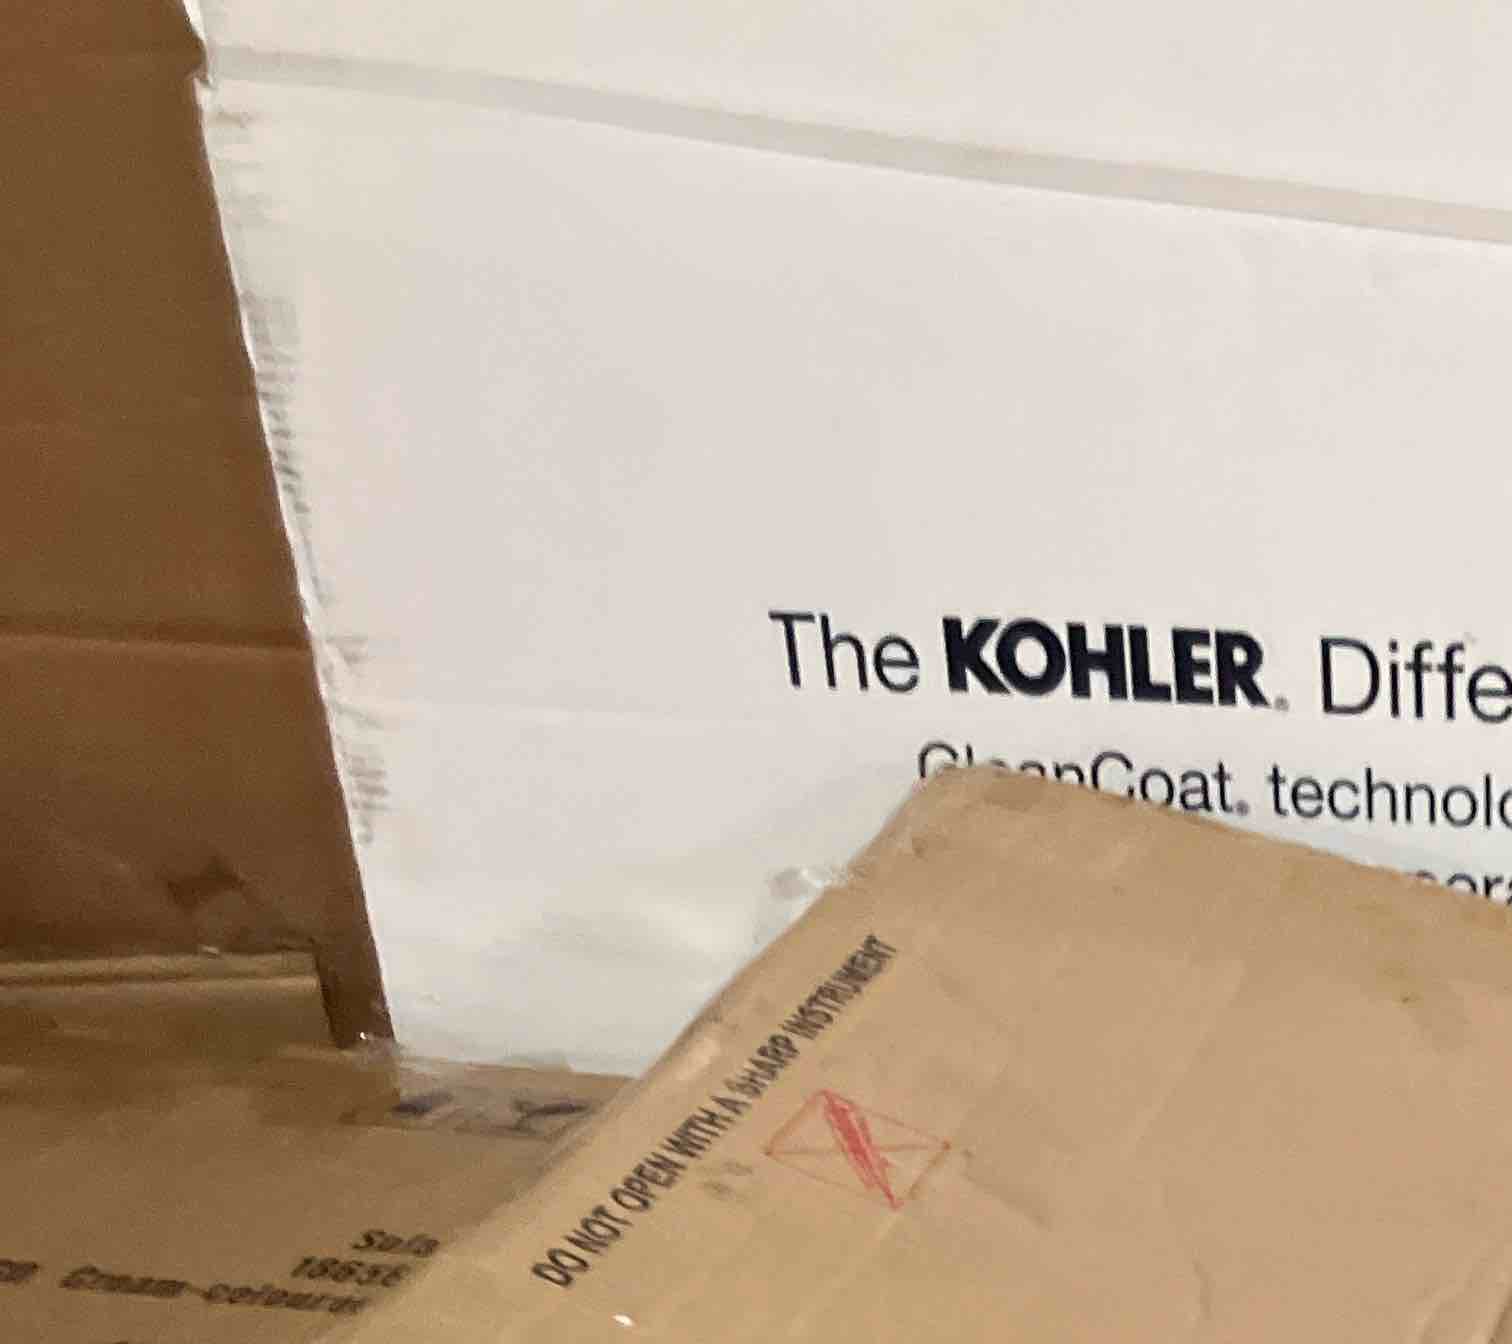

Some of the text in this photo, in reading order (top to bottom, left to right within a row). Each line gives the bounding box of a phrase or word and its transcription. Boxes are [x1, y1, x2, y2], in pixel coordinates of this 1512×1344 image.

[768, 612, 920, 693] The
[530, 1247, 590, 1289] DO
[564, 1204, 634, 1256] NOT
[609, 1151, 688, 1214] OPEN
[659, 1106, 736, 1160] WITH
[710, 1095, 752, 1116] A
[778, 934, 898, 1040] INSTRUMENT
